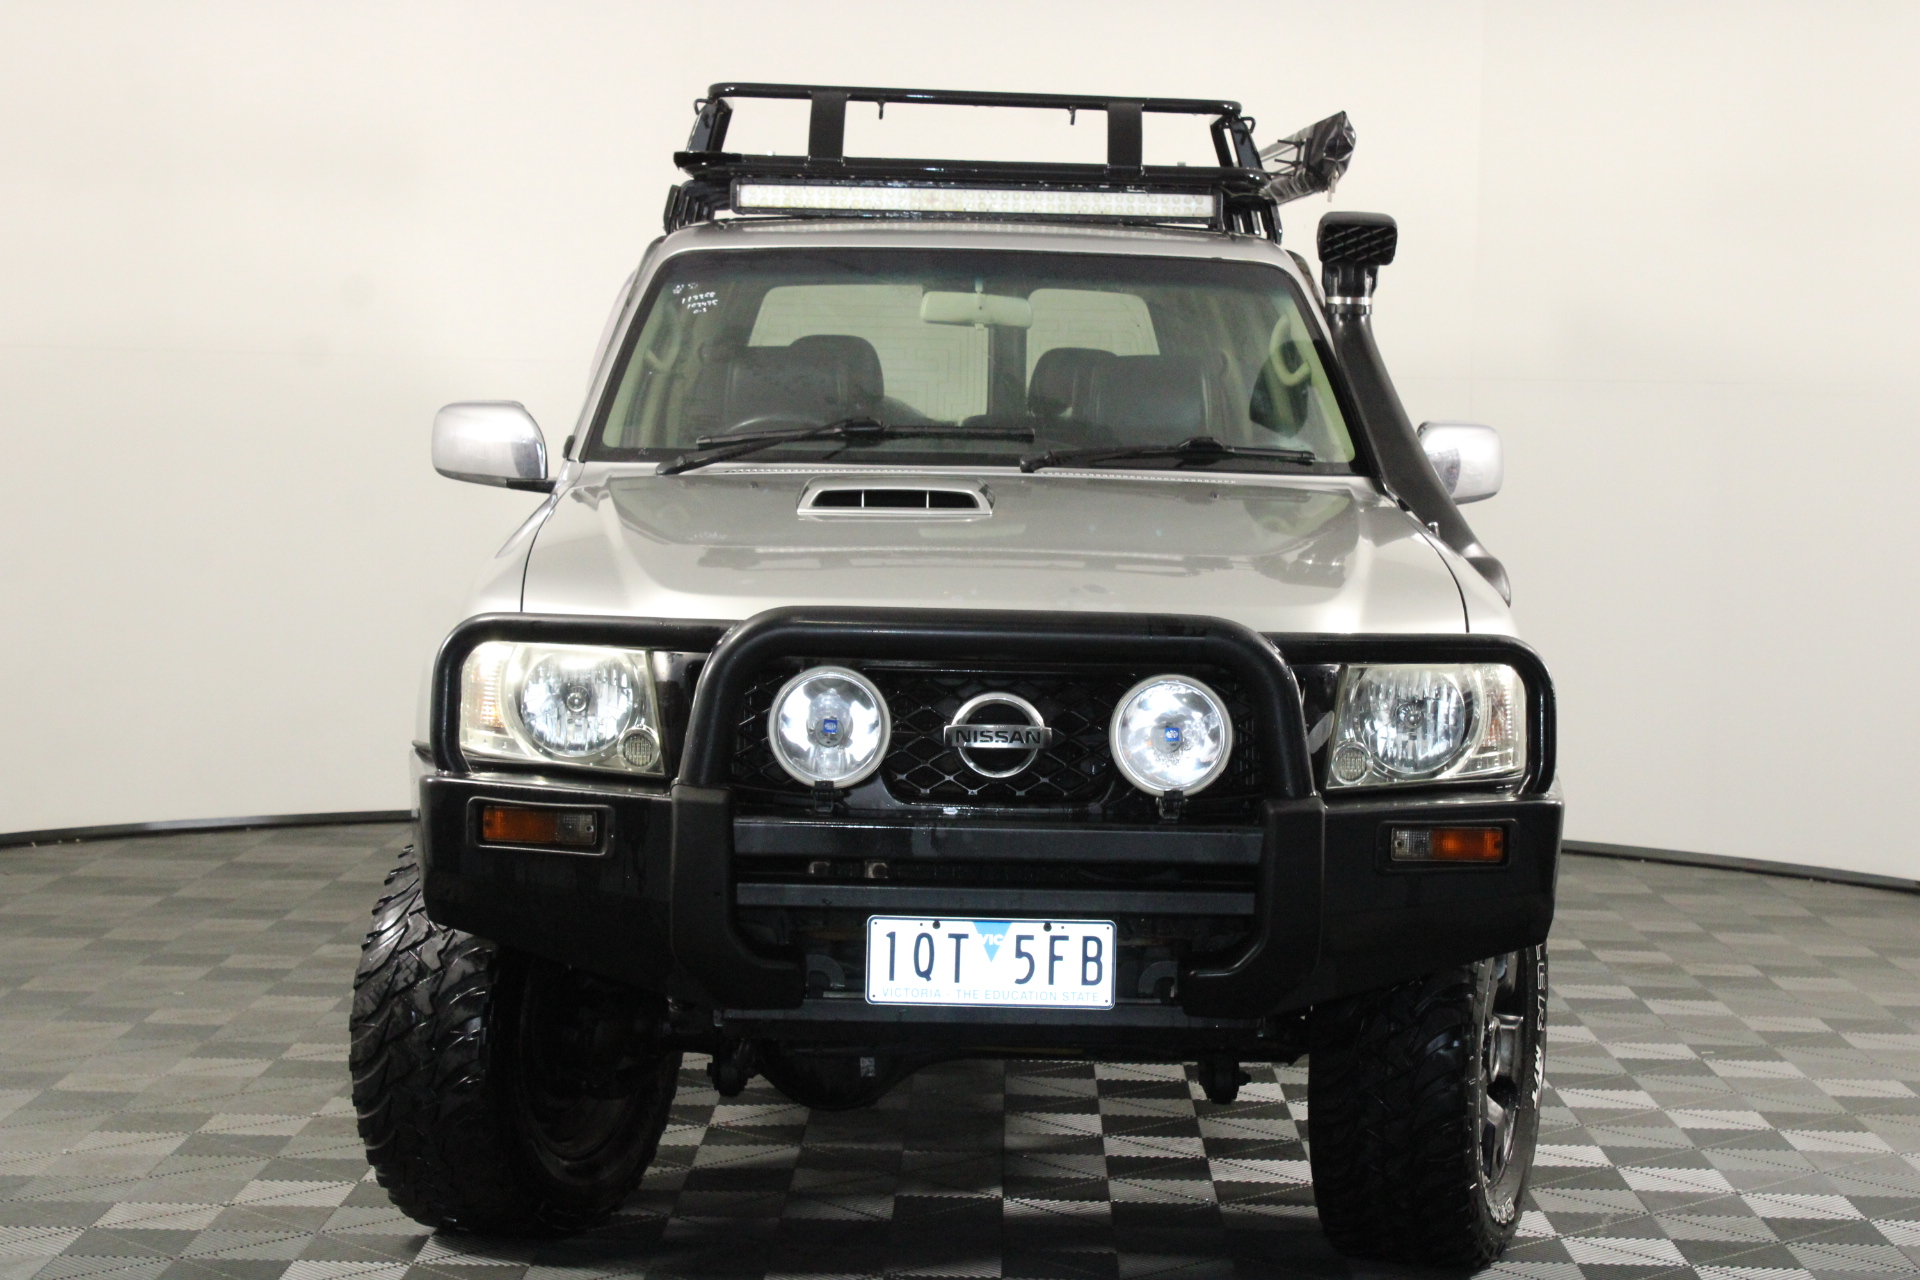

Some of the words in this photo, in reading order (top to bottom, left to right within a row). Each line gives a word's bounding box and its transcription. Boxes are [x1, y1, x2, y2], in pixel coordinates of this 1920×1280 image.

[955, 730, 1040, 744] NISSAN
[886, 931, 969, 983] 1QT
[1014, 934, 1103, 986] 5FB
[882, 987, 941, 999] VICTORIA
[956, 989, 979, 1000] THE
[984, 990, 1057, 1001] EDUCATION
[1063, 991, 1099, 1002] STATE
